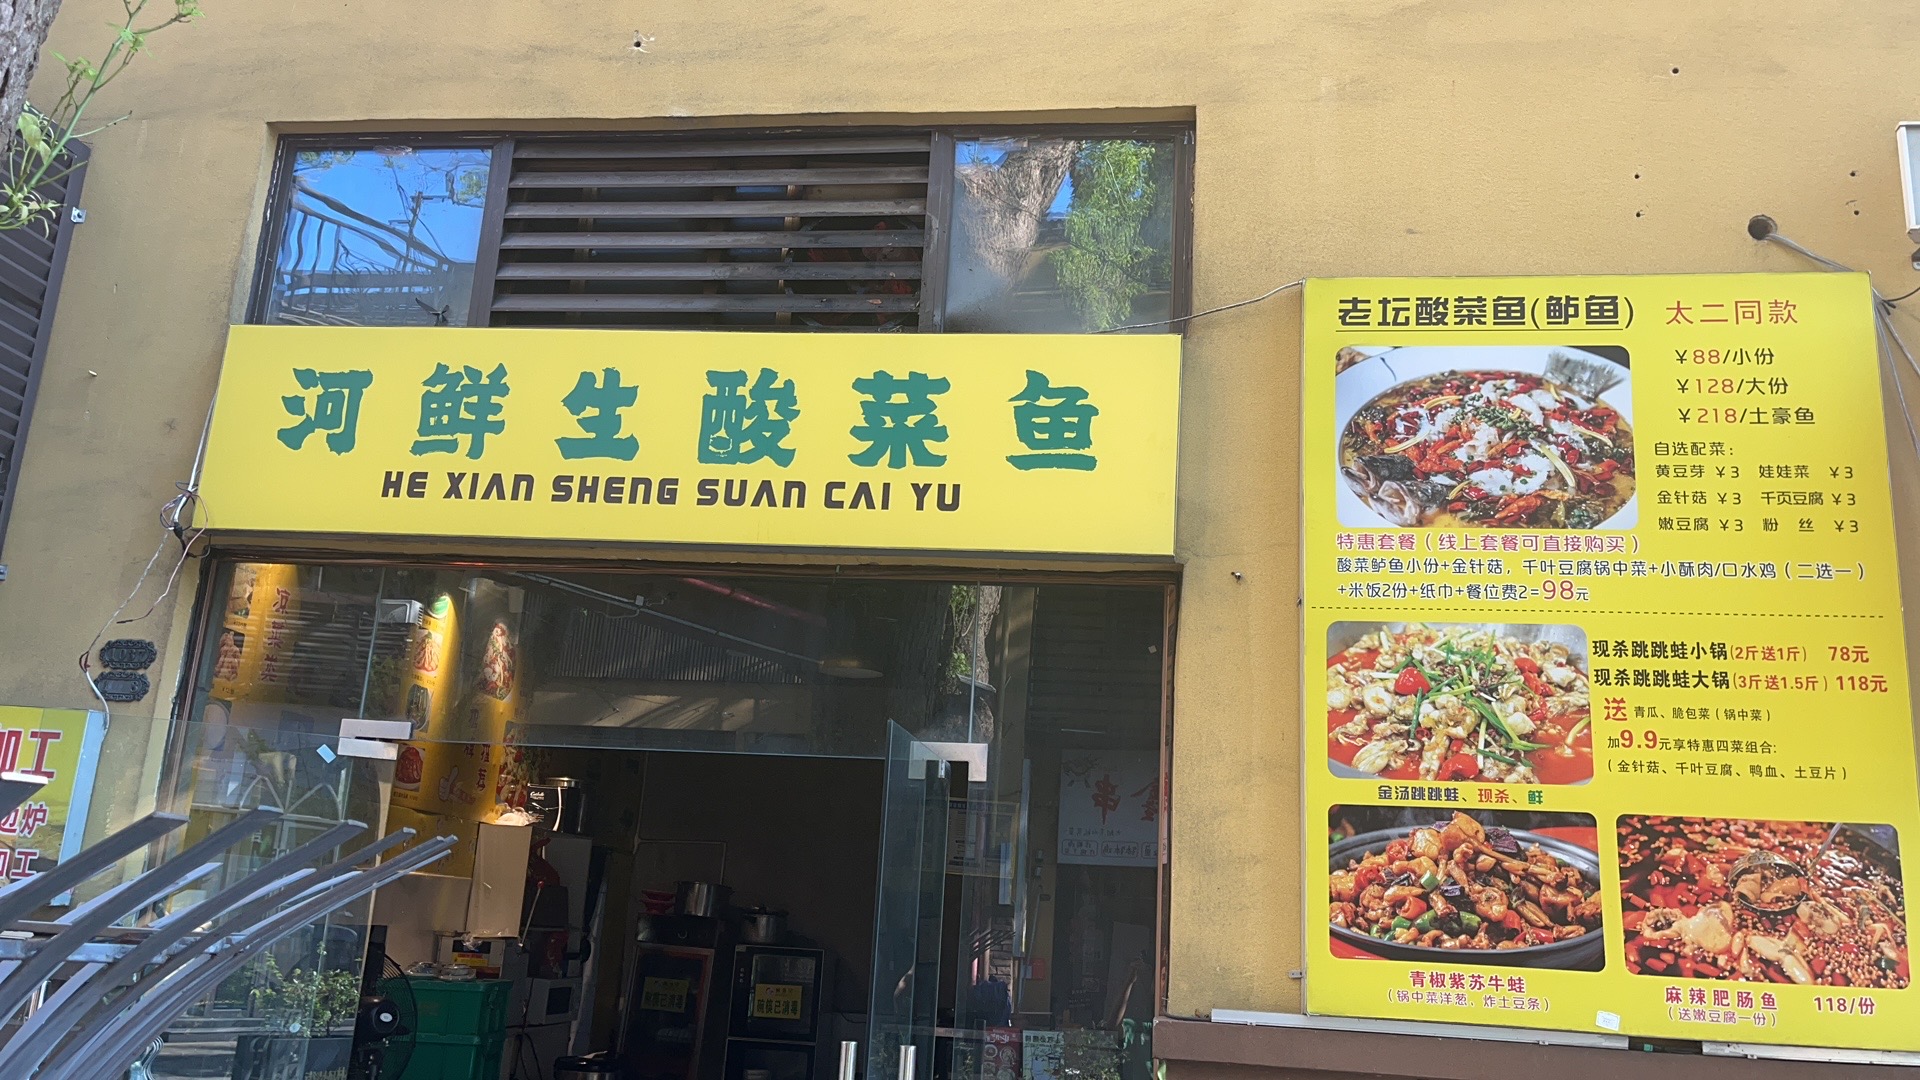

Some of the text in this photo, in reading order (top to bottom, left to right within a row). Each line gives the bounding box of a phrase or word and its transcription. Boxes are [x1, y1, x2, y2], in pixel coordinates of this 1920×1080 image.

[1337, 295, 1799, 330] 老坛酸菜鱼(鲈鱼) 太二同款
[1675, 347, 1775, 367] ¥88/小份
[1676, 376, 1789, 396] ¥128/大份
[277, 363, 1101, 471] 河鲜生酸菜鱼
[1679, 407, 1816, 426] ¥218/土豪鱼
[1654, 441, 1734, 456] 自选配菜:
[1655, 464, 1705, 478] 黄豆芽
[1759, 464, 1810, 479] 娃娃菜
[381, 471, 961, 512] HE XIAN SHENG SUAN CAI YU
[1657, 490, 1707, 505] 金针菇
[1760, 491, 1824, 506] 千页豆腐
[1658, 517, 1709, 531] 嫩豆腐
[1828, 646, 1870, 663] 78元
[1836, 675, 1888, 693] 118元
[1603, 697, 1628, 721] 送
[1409, 970, 1526, 994] 青椒紫苏牛蛙
[756, 998, 799, 1017] 碗筷已消毒
[1665, 986, 1876, 1015] 麻辣肥肠鱼 118/份
[1667, 1007, 1777, 1027] （送嫩豆腐一份）
